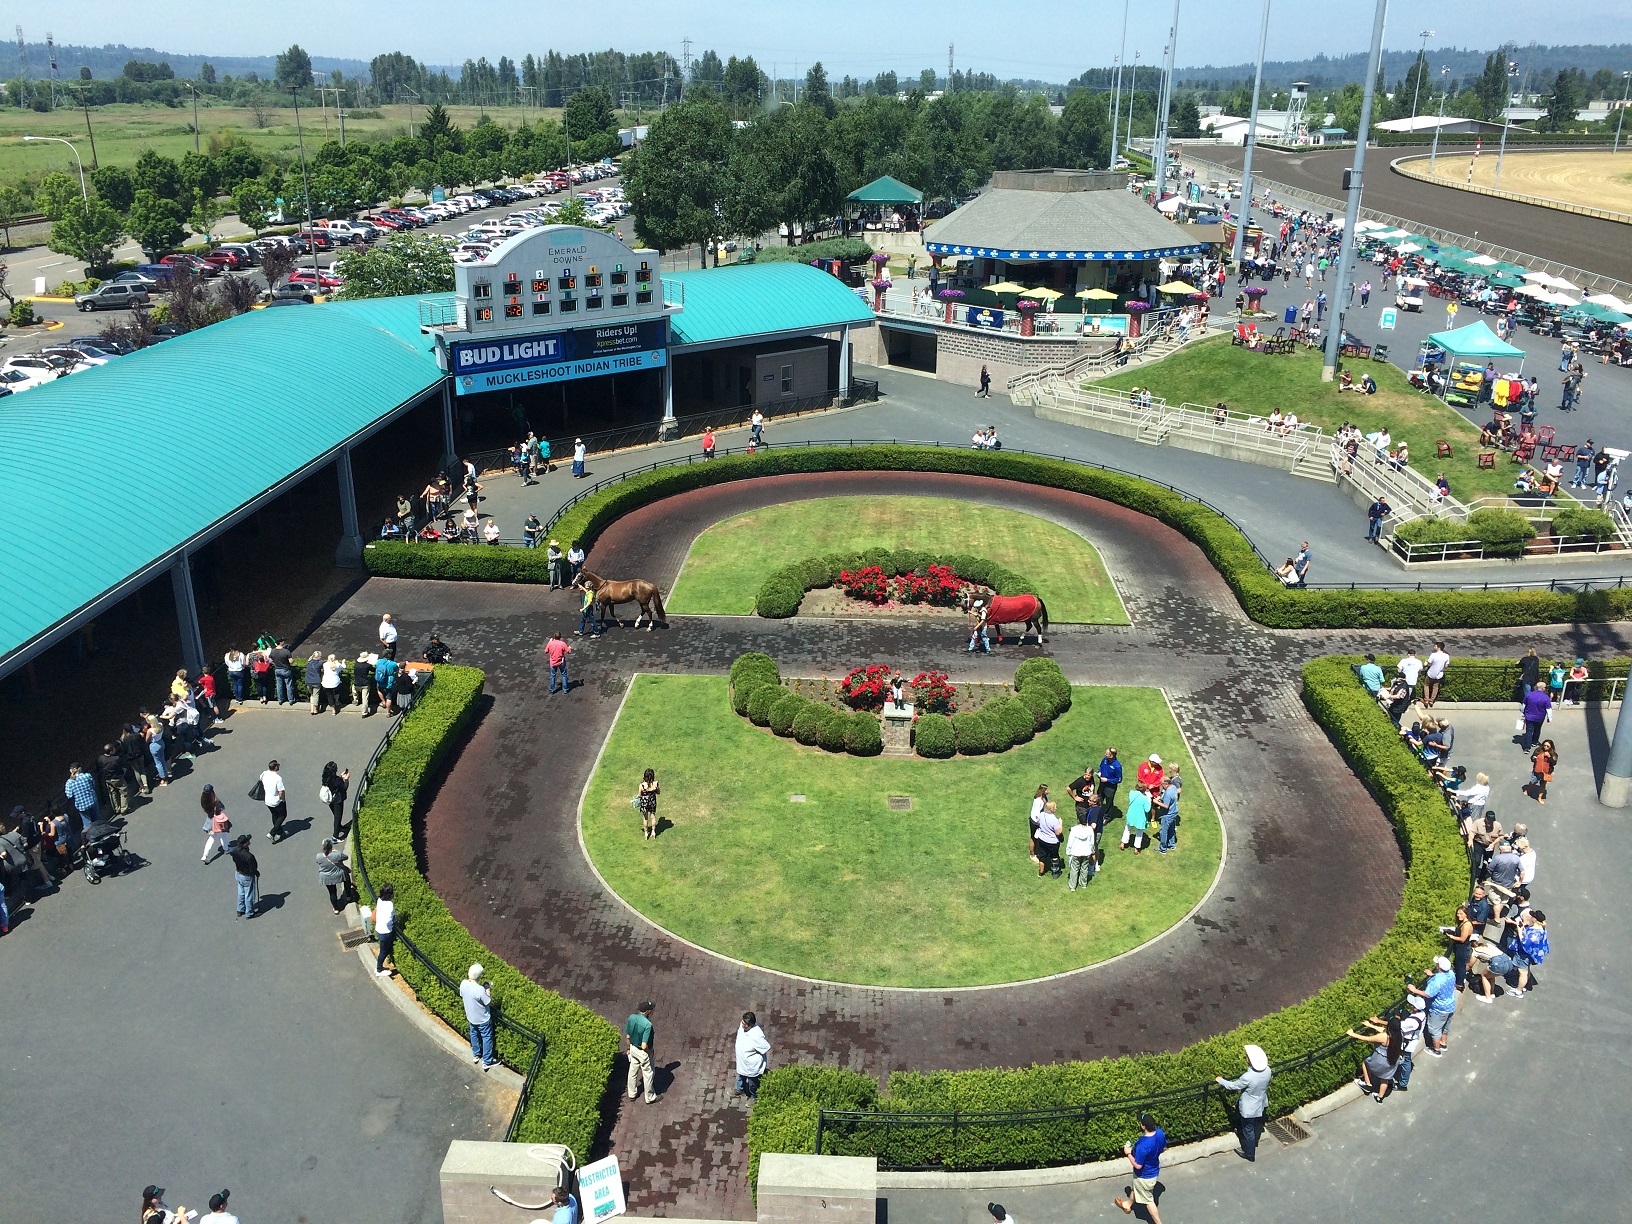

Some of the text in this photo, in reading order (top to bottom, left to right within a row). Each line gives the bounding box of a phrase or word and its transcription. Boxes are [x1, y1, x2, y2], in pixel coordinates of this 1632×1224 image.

[548, 245, 587, 256] EMERALD
[553, 255, 584, 264] DOWNS
[515, 283, 521, 293] 3
[568, 277, 575, 288] 6
[596, 324, 637, 338] Riders Up!
[596, 336, 638, 348] xpressbet.com
[460, 339, 557, 367] BUD LIGHT
[486, 356, 643, 387] MUCKLESHOOT INDIAN TRIBE
[580, 1164, 617, 1188] RESTRICTED
[594, 1186, 610, 1201] AREA
